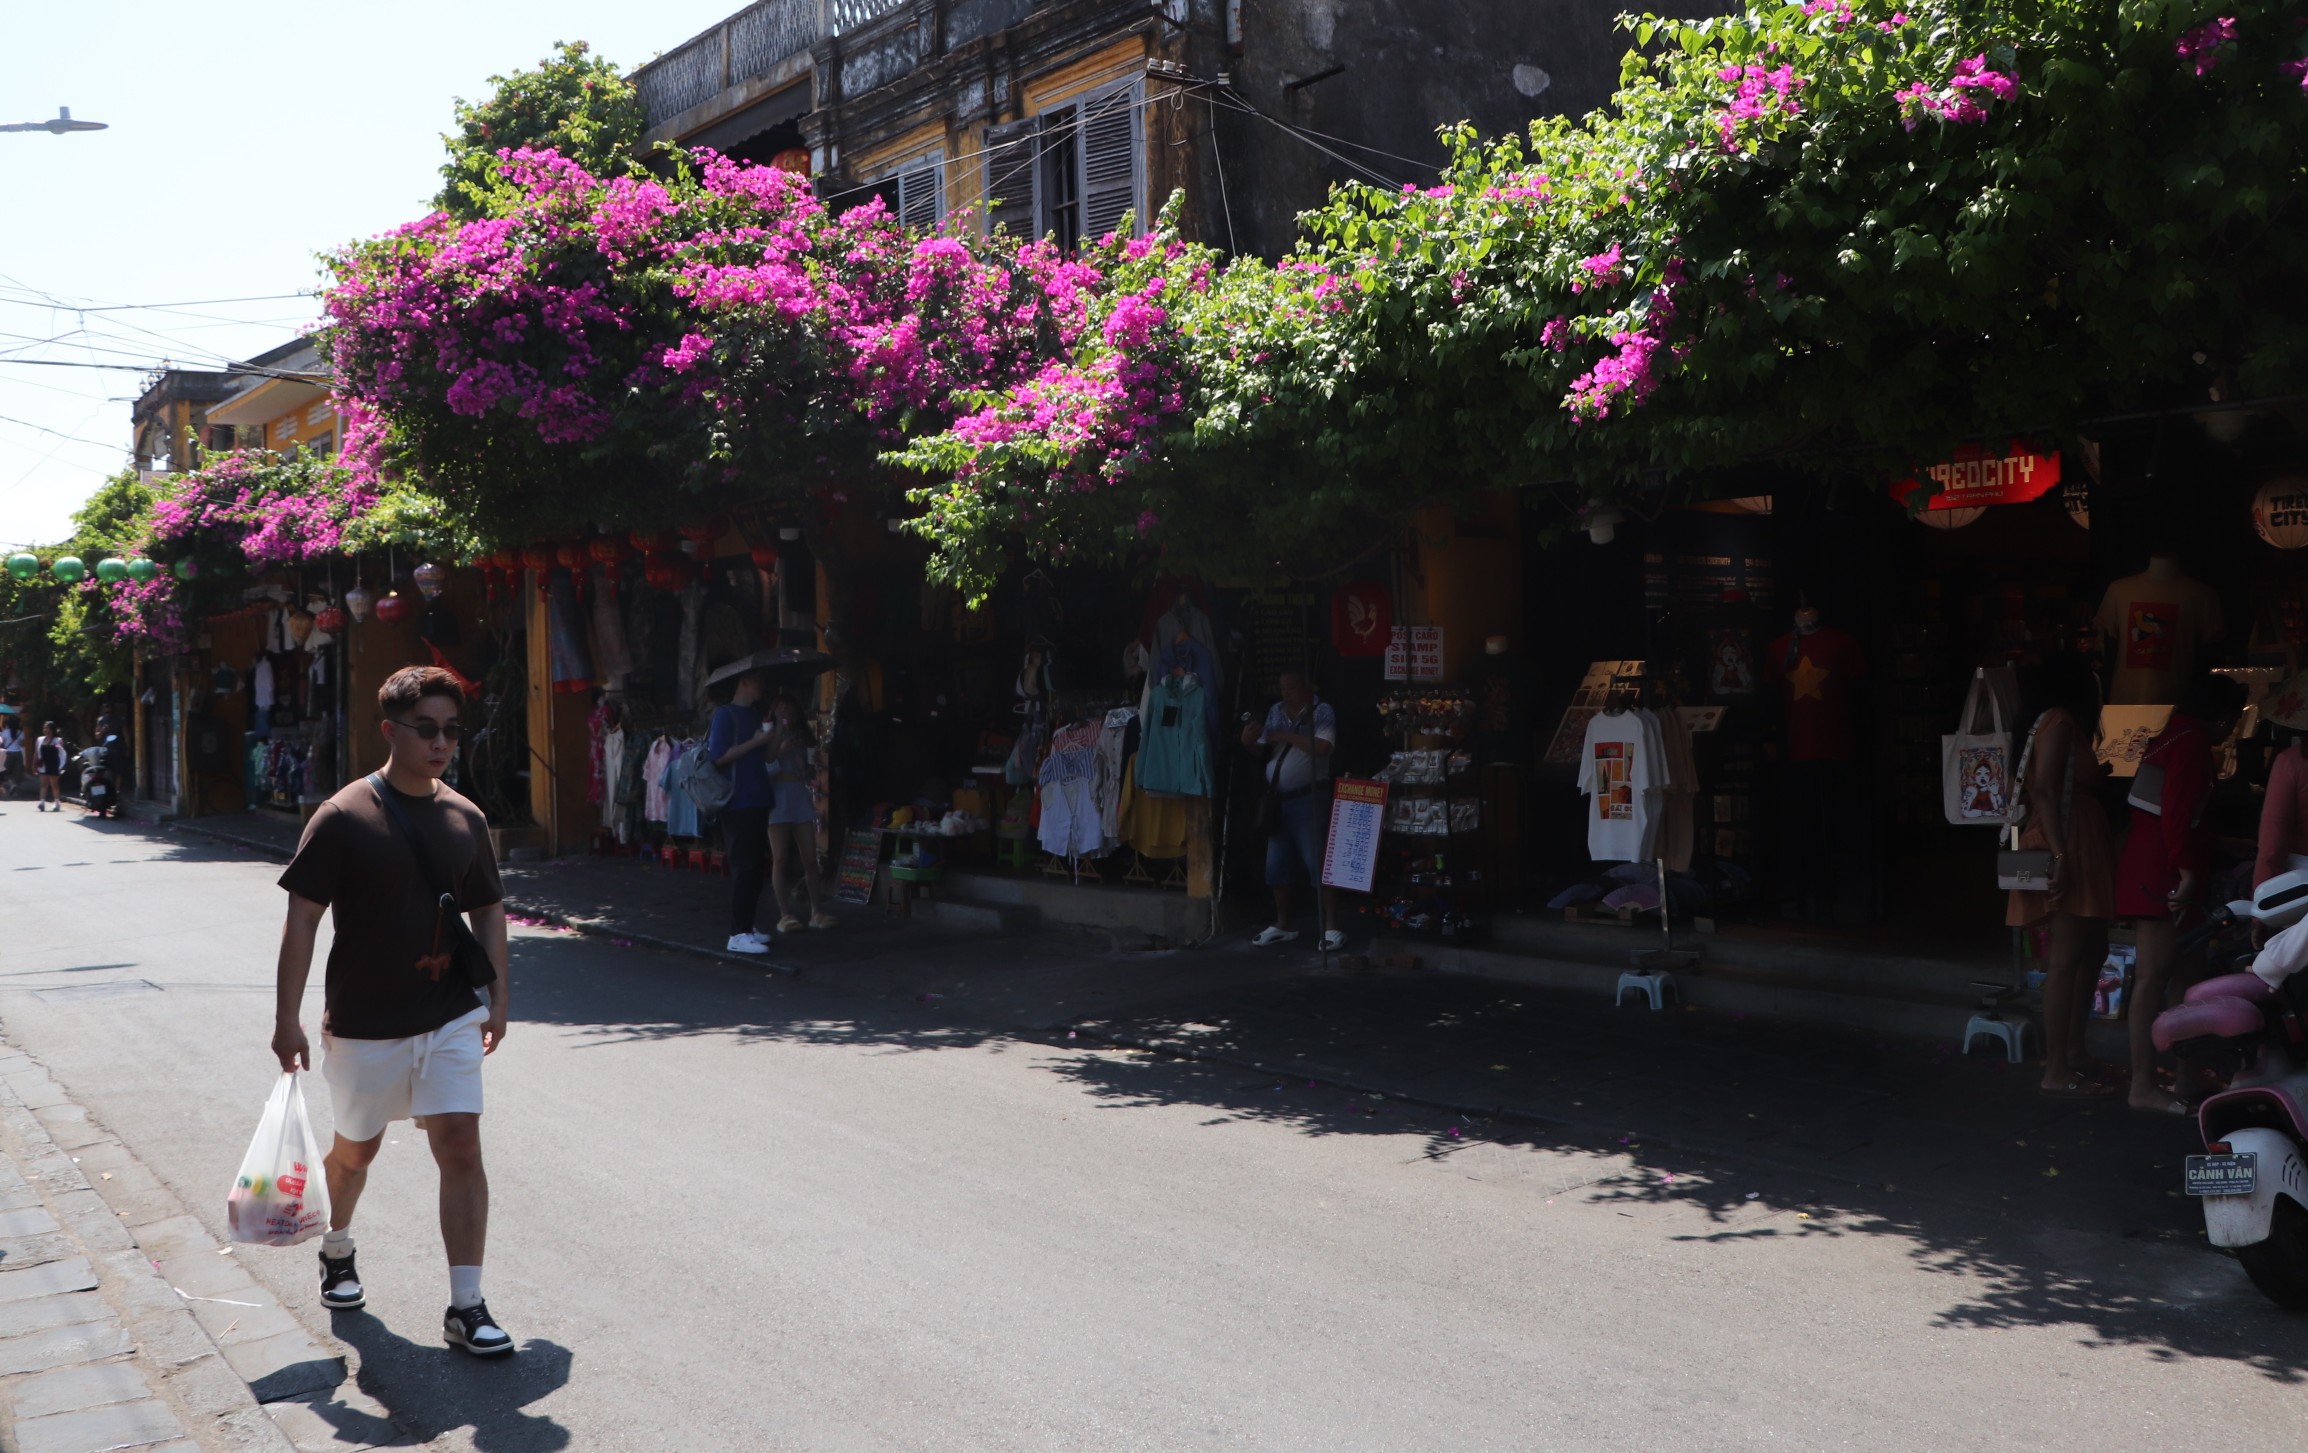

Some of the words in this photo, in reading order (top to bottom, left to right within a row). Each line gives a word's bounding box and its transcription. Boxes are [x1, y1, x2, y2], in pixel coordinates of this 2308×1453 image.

[1915, 455, 2034, 491] IREDCITY
[1416, 631, 1439, 640] CARD
[1391, 643, 1438, 652] STAMP
[1391, 654, 1417, 663] SIM
[1422, 655, 1439, 664] 5G
[1390, 666, 1419, 675] EXCHAGE
[1338, 783, 1365, 796] EXCHANGE
[1365, 785, 1384, 798] MONEY
[2227, 1166, 2253, 1179] VÂN
